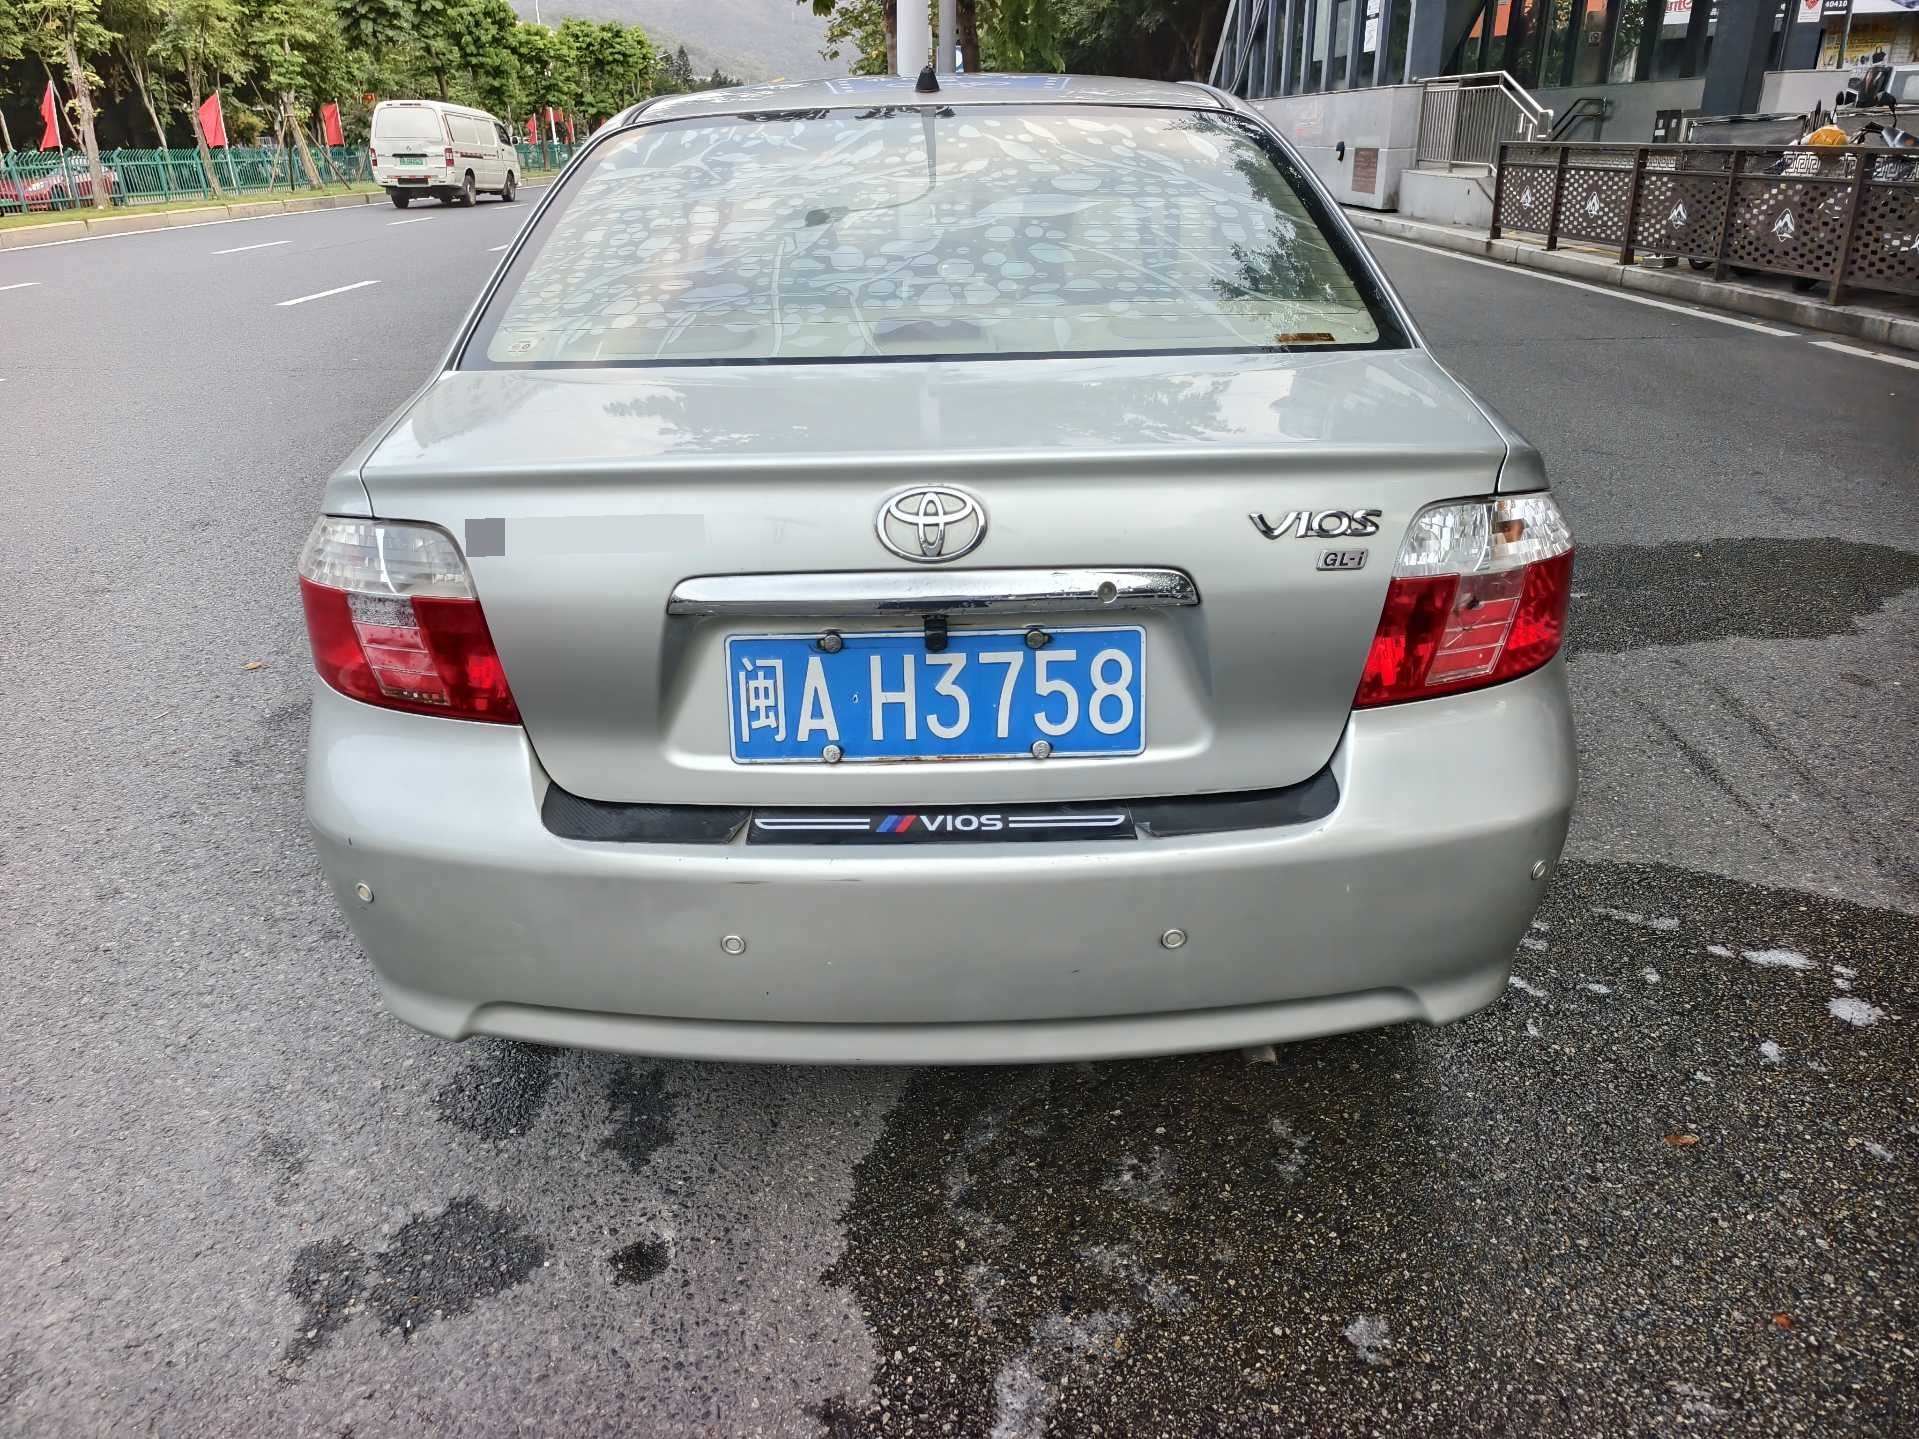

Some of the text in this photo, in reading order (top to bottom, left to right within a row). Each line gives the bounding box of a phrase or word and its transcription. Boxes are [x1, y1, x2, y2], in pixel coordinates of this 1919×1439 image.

[1248, 510, 1382, 540] VIOS
[1324, 551, 1364, 567] GL-i
[919, 814, 1004, 832] VIOS
